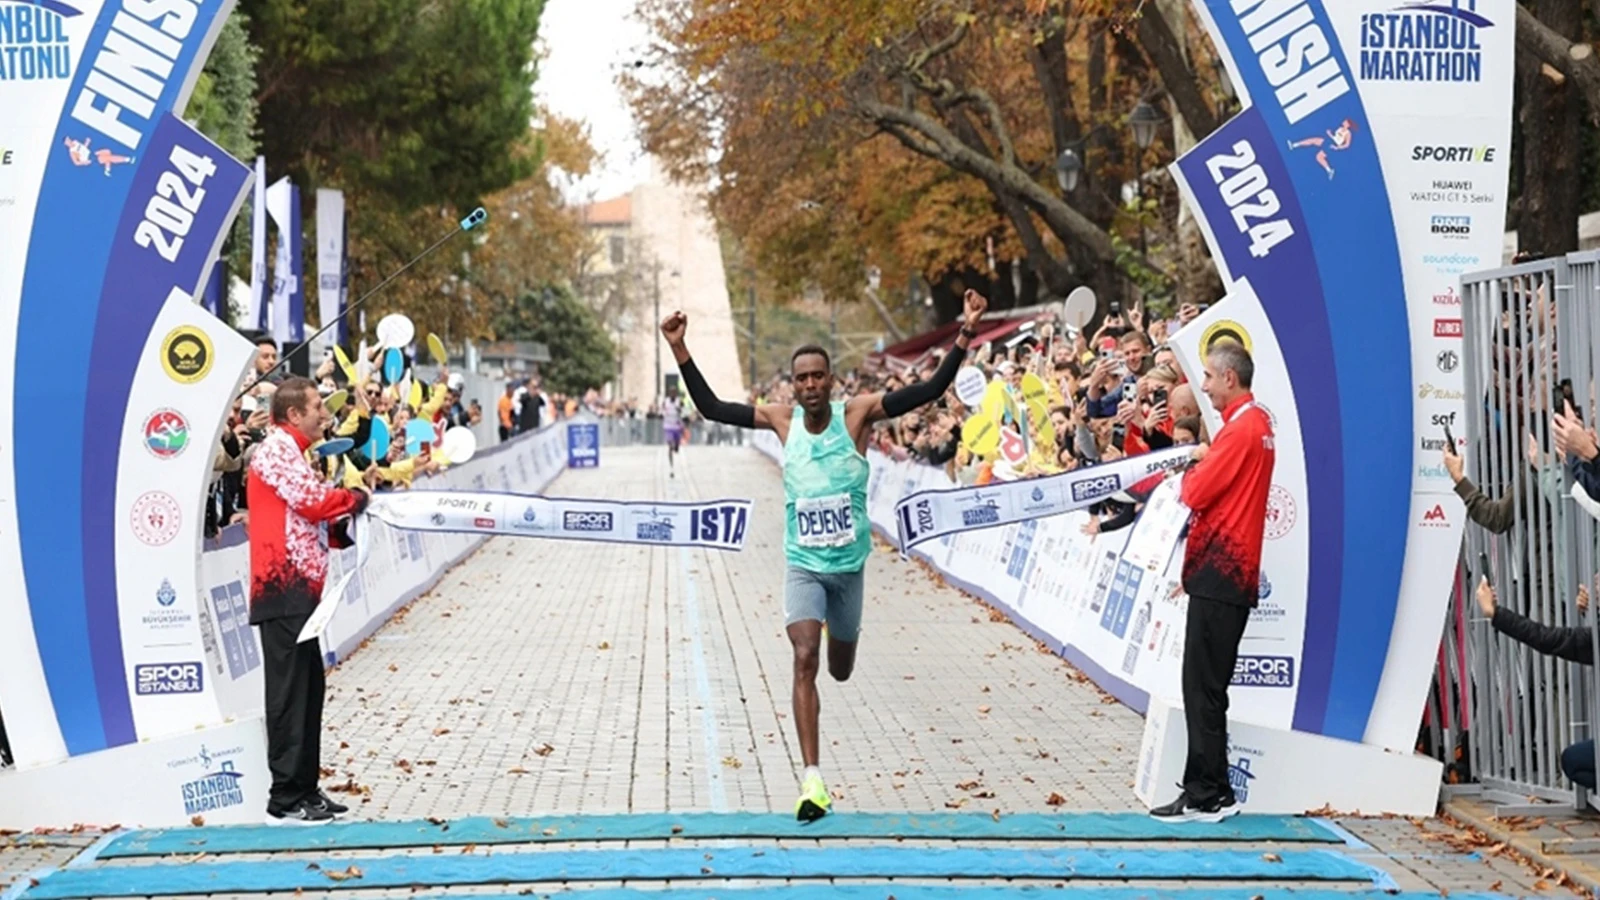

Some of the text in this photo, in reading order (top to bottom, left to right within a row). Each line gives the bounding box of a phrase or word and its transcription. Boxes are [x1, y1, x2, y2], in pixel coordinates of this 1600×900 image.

[1360, 50, 1481, 82] MARATHON
[71, 0, 203, 150] FINIS
[1411, 146, 1496, 162] SPORTIVE
[1432, 181, 1472, 190] HUAWEI
[133, 144, 217, 263] 2024
[1205, 139, 1295, 258] 2024
[1410, 192, 1445, 202] WATCH
[1431, 225, 1470, 234] BOND
[1423, 252, 1480, 264] soundcore
[1073, 477, 1117, 491] SPOR
[566, 513, 611, 523] SPOR
[797, 506, 852, 537] DEJENE
[917, 499, 935, 534] 2024
[138, 664, 199, 682] SPOR
[1234, 658, 1290, 674] SPOR
[184, 789, 244, 816] MARATONU
